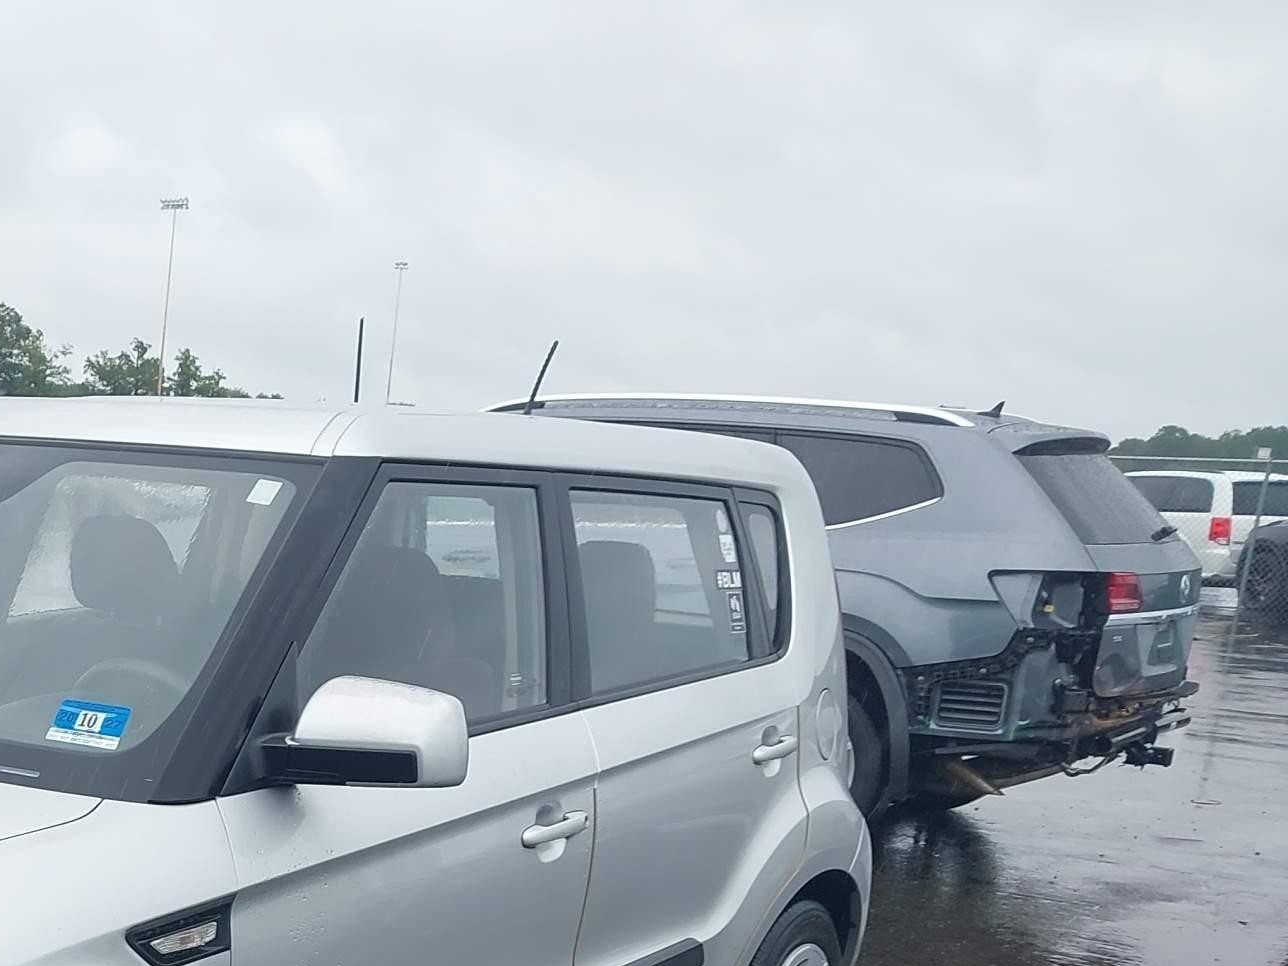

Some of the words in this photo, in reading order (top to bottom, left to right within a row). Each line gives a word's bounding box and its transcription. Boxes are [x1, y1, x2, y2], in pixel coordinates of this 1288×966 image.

[61, 711, 75, 722] 20
[78, 712, 98, 728] 10
[105, 719, 123, 730] 27
